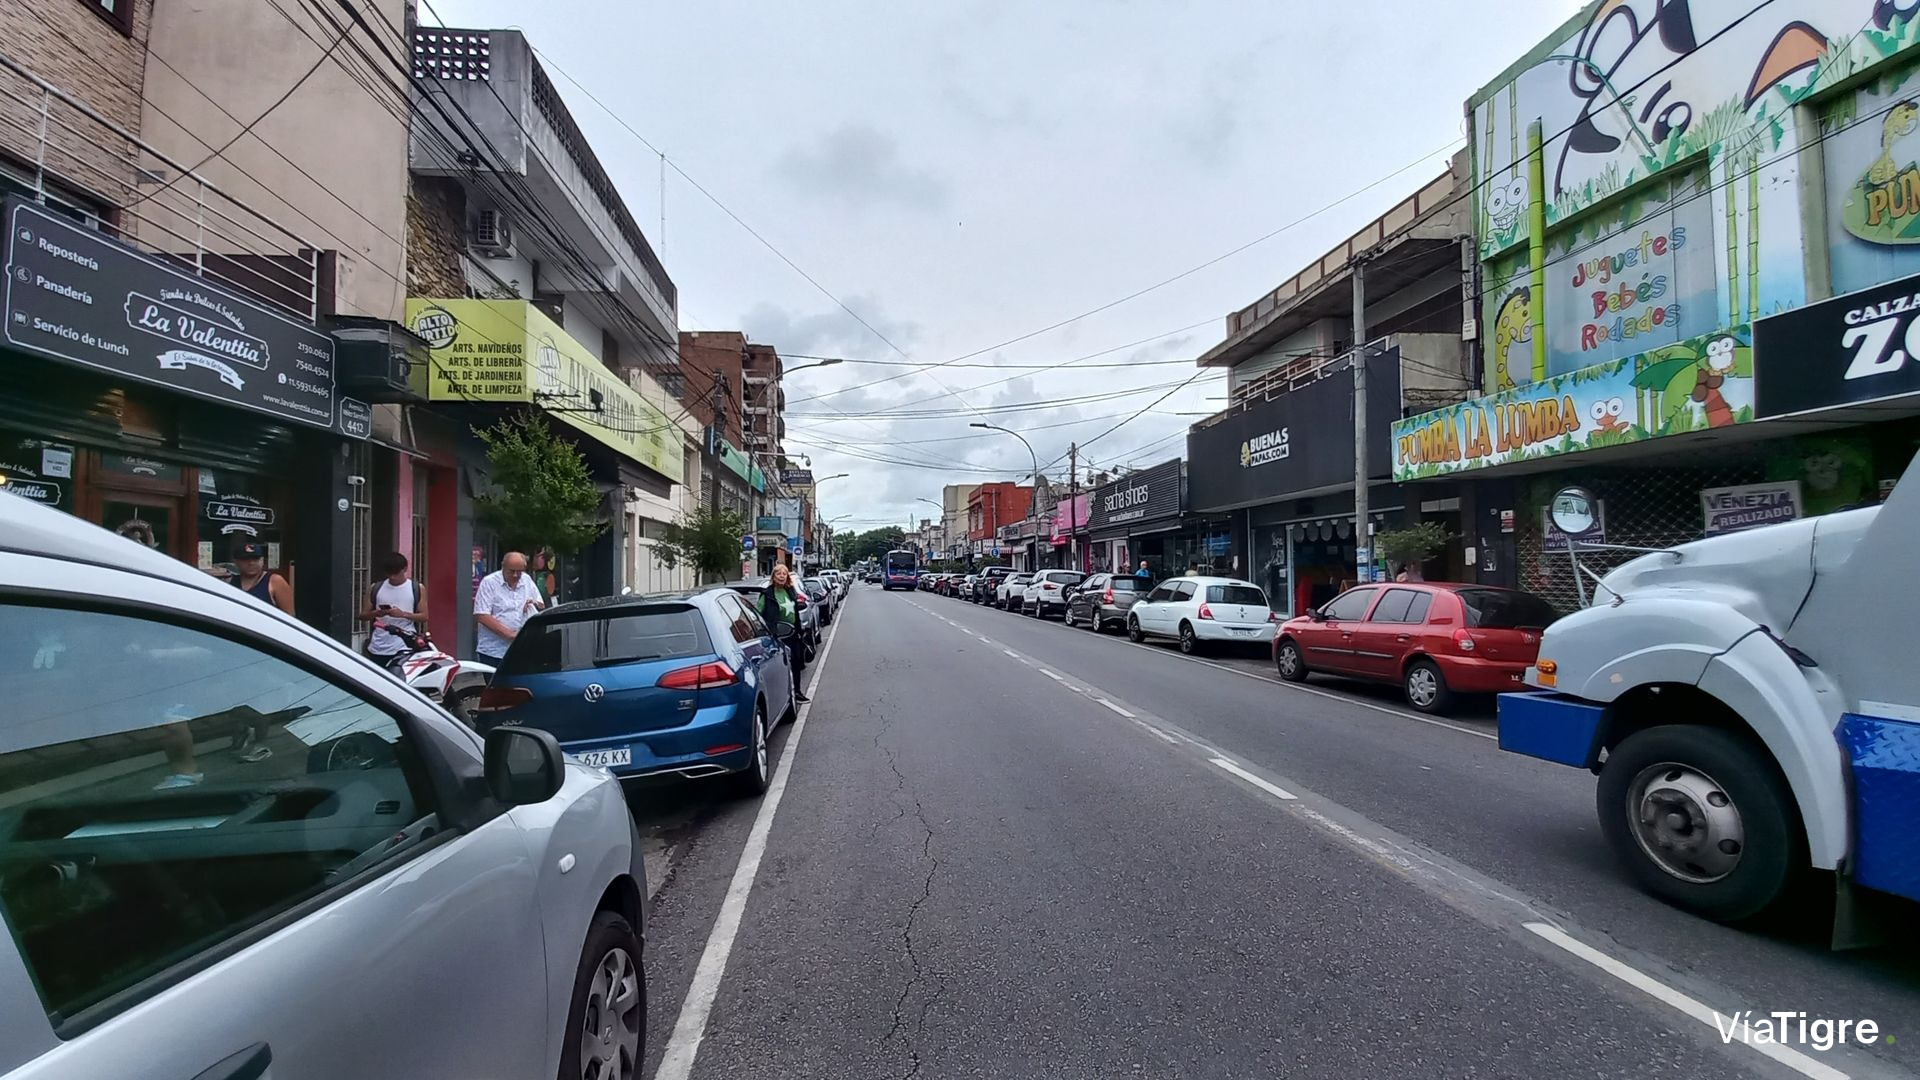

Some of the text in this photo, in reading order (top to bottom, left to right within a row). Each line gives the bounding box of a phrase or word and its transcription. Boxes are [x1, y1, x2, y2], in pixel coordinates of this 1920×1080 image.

[38, 237, 99, 271] Repostería
[1572, 227, 1686, 287] Juguetes
[36, 275, 92, 305] Panadería
[1592, 273, 1667, 319] Bebés
[33, 317, 129, 355] Servicio de Lunch
[139, 305, 259, 362] La Valenttia
[419, 315, 449, 330] ALTO
[1581, 304, 1681, 351] Rodados
[453, 342, 522, 353] ARTS. NAVIDEÑOS
[438, 371, 522, 380] ARTS. DE JARDINERIA
[449, 358, 522, 367] ARTS. DE LIBRERIA
[472, 385, 482, 394] DE
[485, 385, 522, 394] LIMPIEZA
[347, 420, 364, 433] 4412
[1250, 427, 1289, 453] BUENAS
[1397, 395, 1581, 465] PUMBA LA LUMBA
[1105, 480, 1148, 512] sacha shoes
[1720, 505, 1793, 527] REALIZADO
[584, 751, 628, 766] 676 KX
